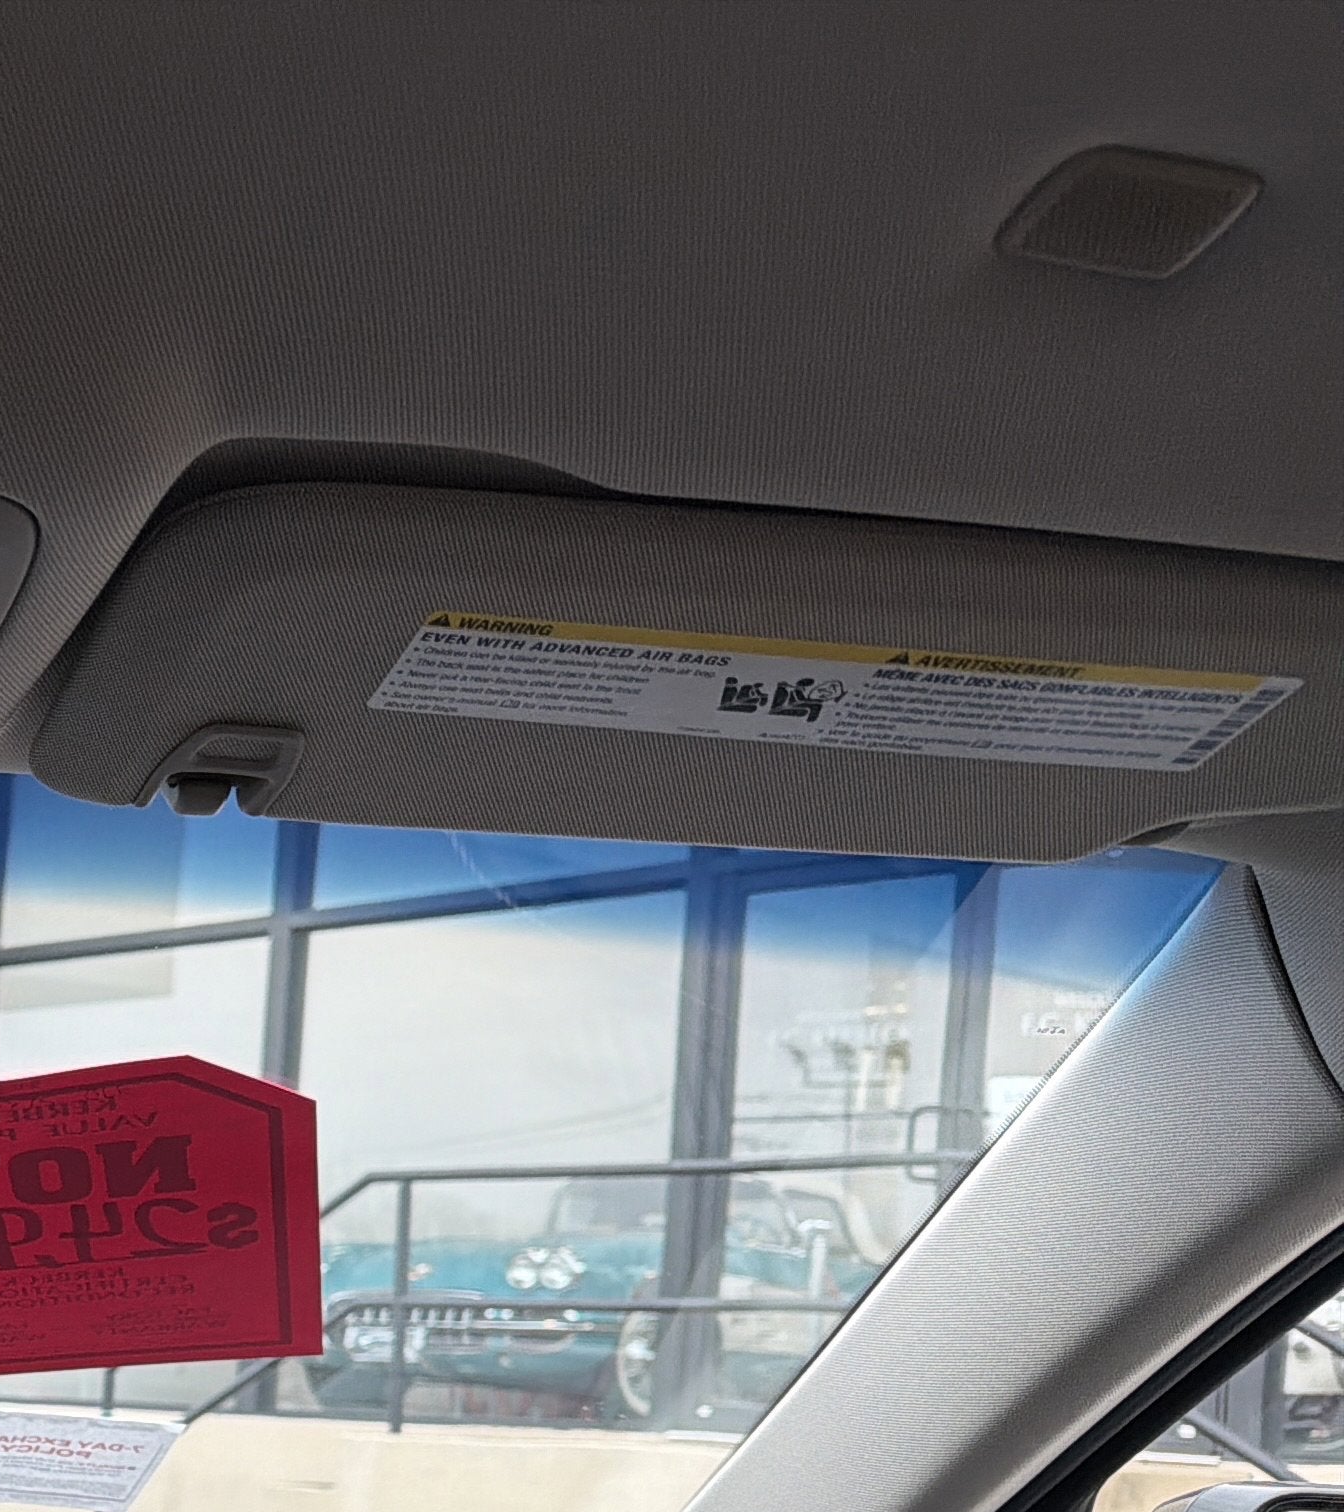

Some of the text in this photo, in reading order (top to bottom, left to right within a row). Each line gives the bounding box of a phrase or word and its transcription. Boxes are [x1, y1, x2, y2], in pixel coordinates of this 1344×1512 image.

[454, 618, 556, 635] WARNING
[419, 632, 734, 666] EVEN WITH ADVANCED AIR BAGS
